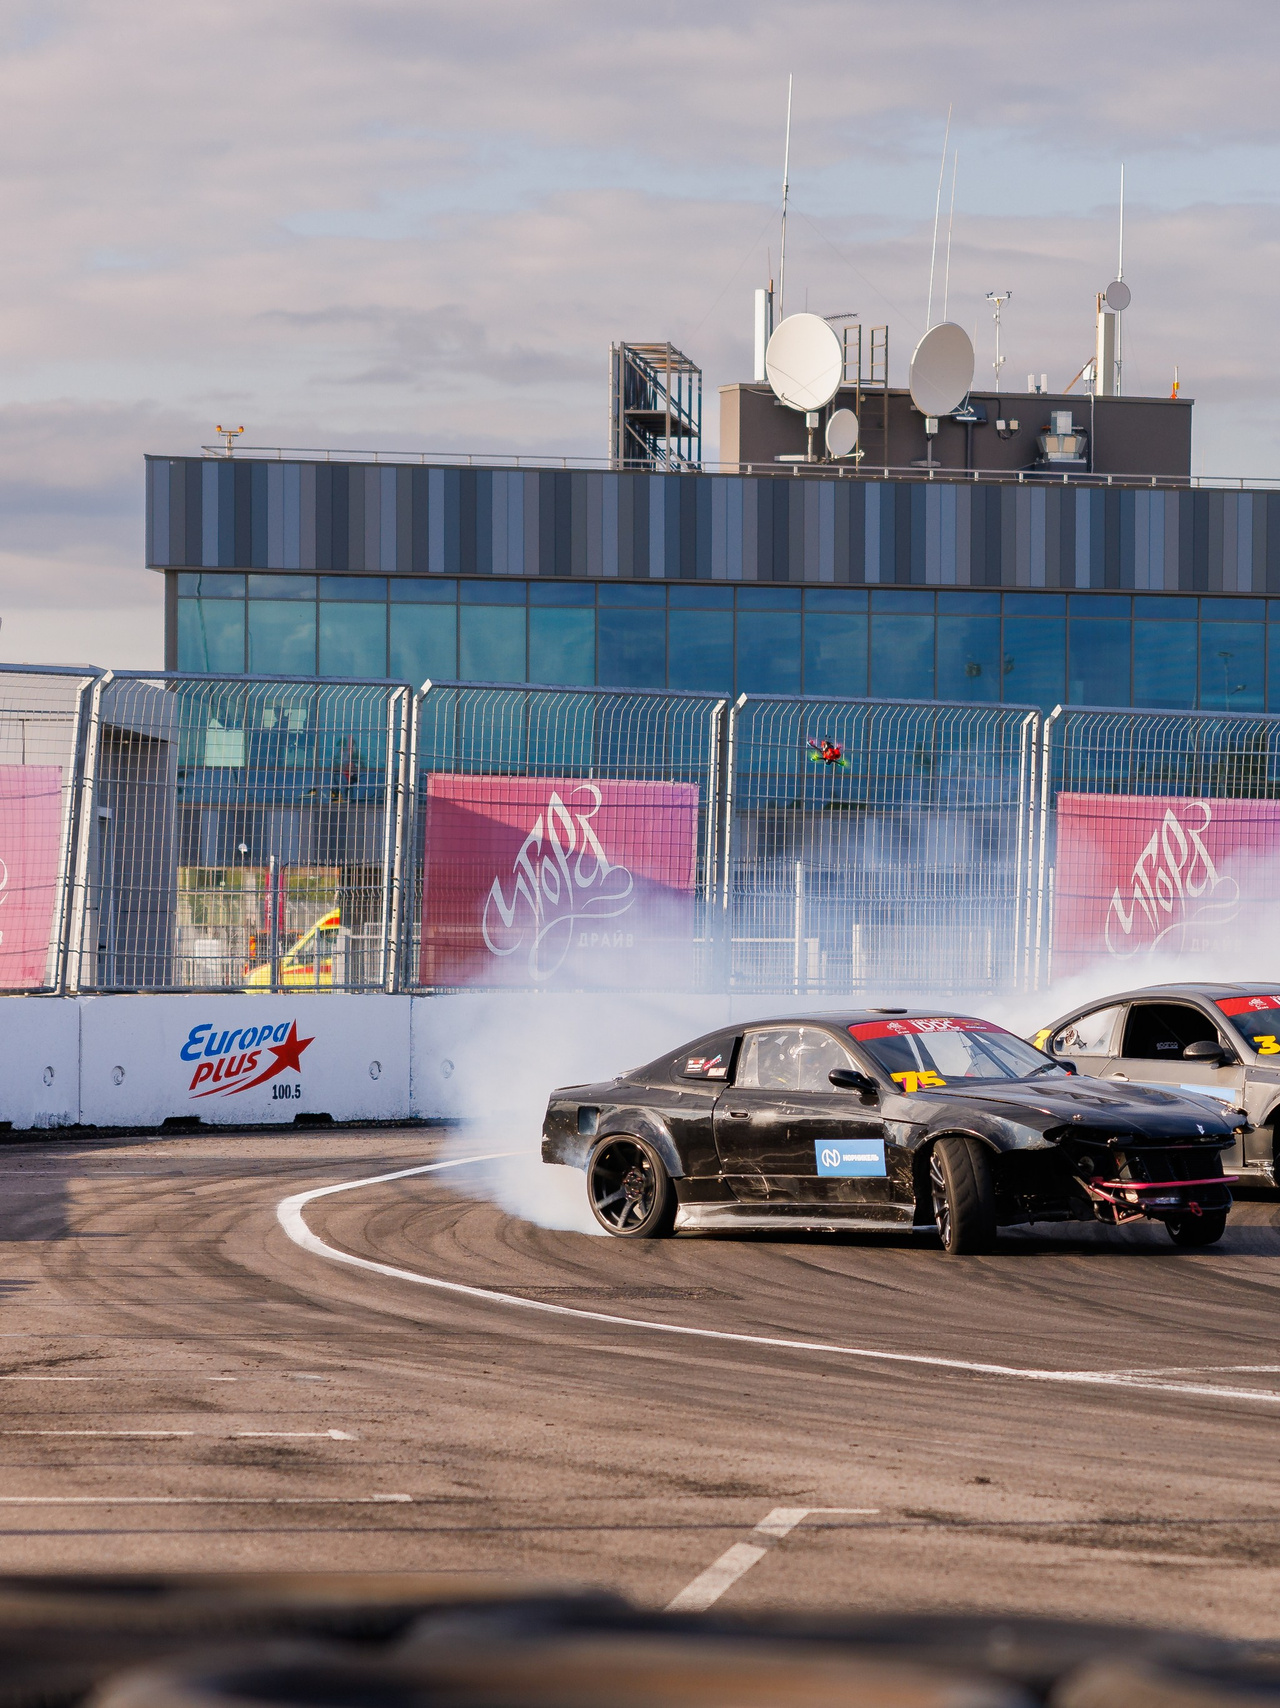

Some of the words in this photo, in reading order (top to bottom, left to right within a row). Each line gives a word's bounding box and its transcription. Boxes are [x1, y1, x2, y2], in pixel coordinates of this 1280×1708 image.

[577, 930, 634, 948] ДРАЙВ
[1253, 1035, 1280, 1055] 3
[890, 1070, 947, 1093] 75
[272, 1084, 301, 1100] 100.5
